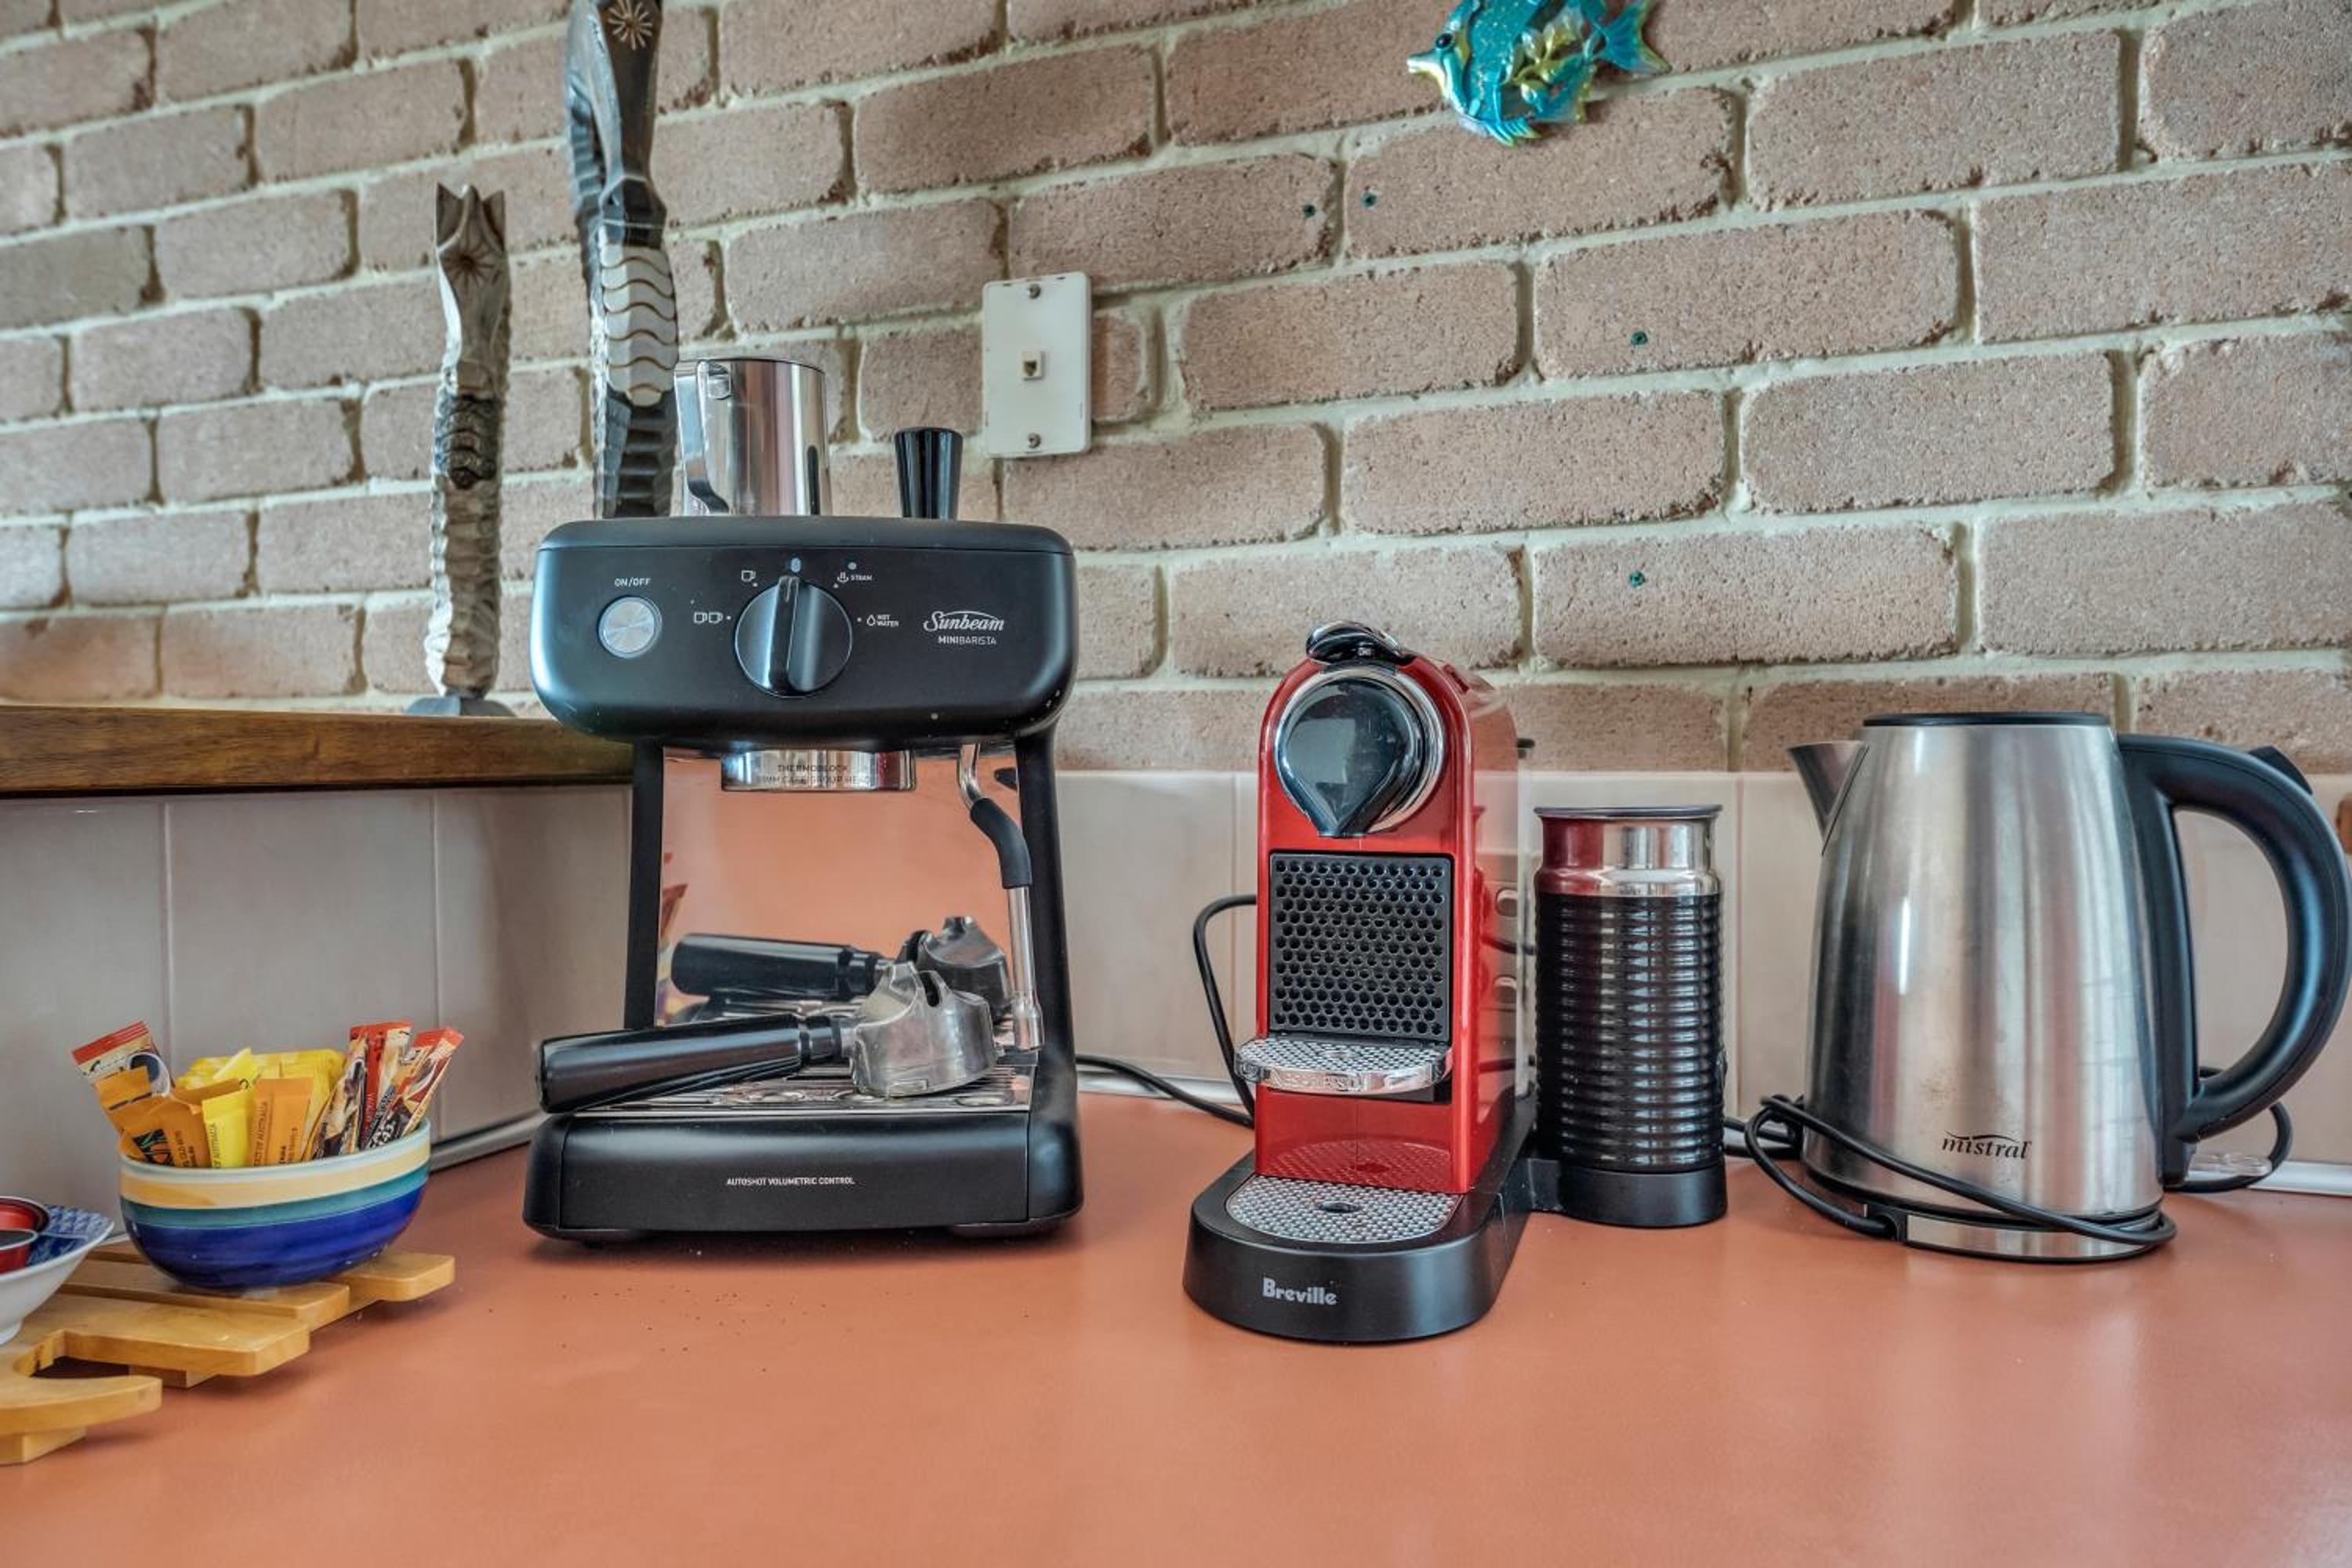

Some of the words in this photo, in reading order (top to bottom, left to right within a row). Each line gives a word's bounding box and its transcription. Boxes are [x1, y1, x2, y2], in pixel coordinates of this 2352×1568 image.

[614, 576, 652, 587] ON/OFF
[923, 611, 1004, 632] Sunbeam
[1941, 1134, 2029, 1160] mistral
[1262, 1276, 1338, 1305] Breville
